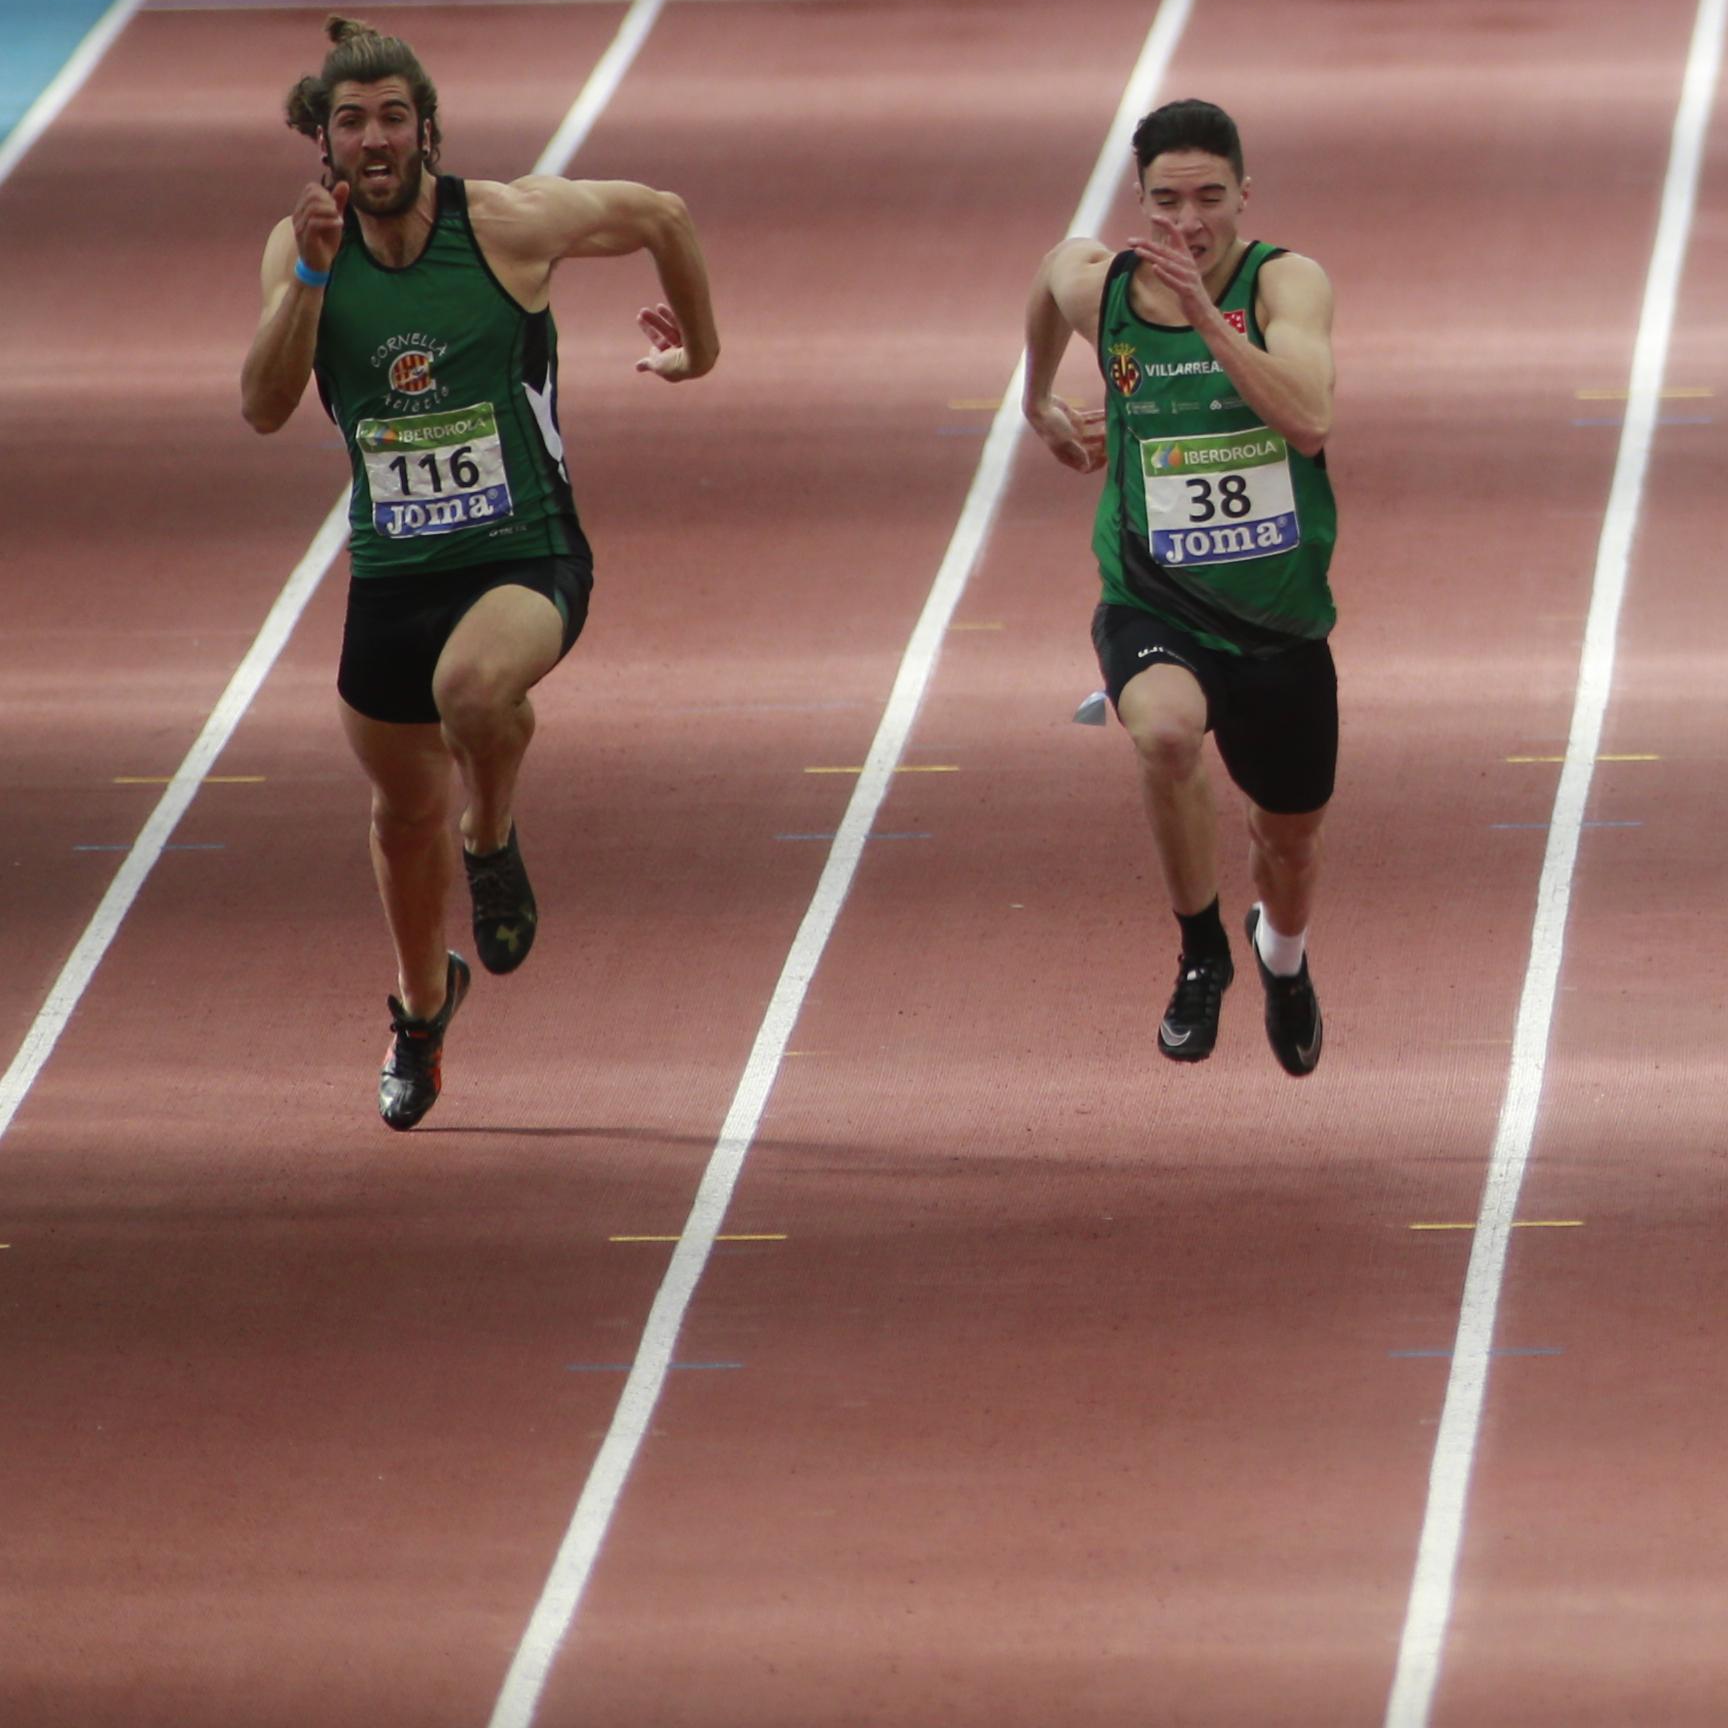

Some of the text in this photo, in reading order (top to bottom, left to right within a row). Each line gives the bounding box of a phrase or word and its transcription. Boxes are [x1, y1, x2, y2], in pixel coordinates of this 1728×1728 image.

[1144, 360, 1224, 377] VILLARREA
[397, 416, 487, 443] IBERDROLA
[389, 445, 480, 496] 116
[1183, 439, 1278, 465] IBERDROLA
[386, 491, 495, 535] Joma
[1185, 474, 1252, 523] 38
[1165, 521, 1284, 563] Joma
